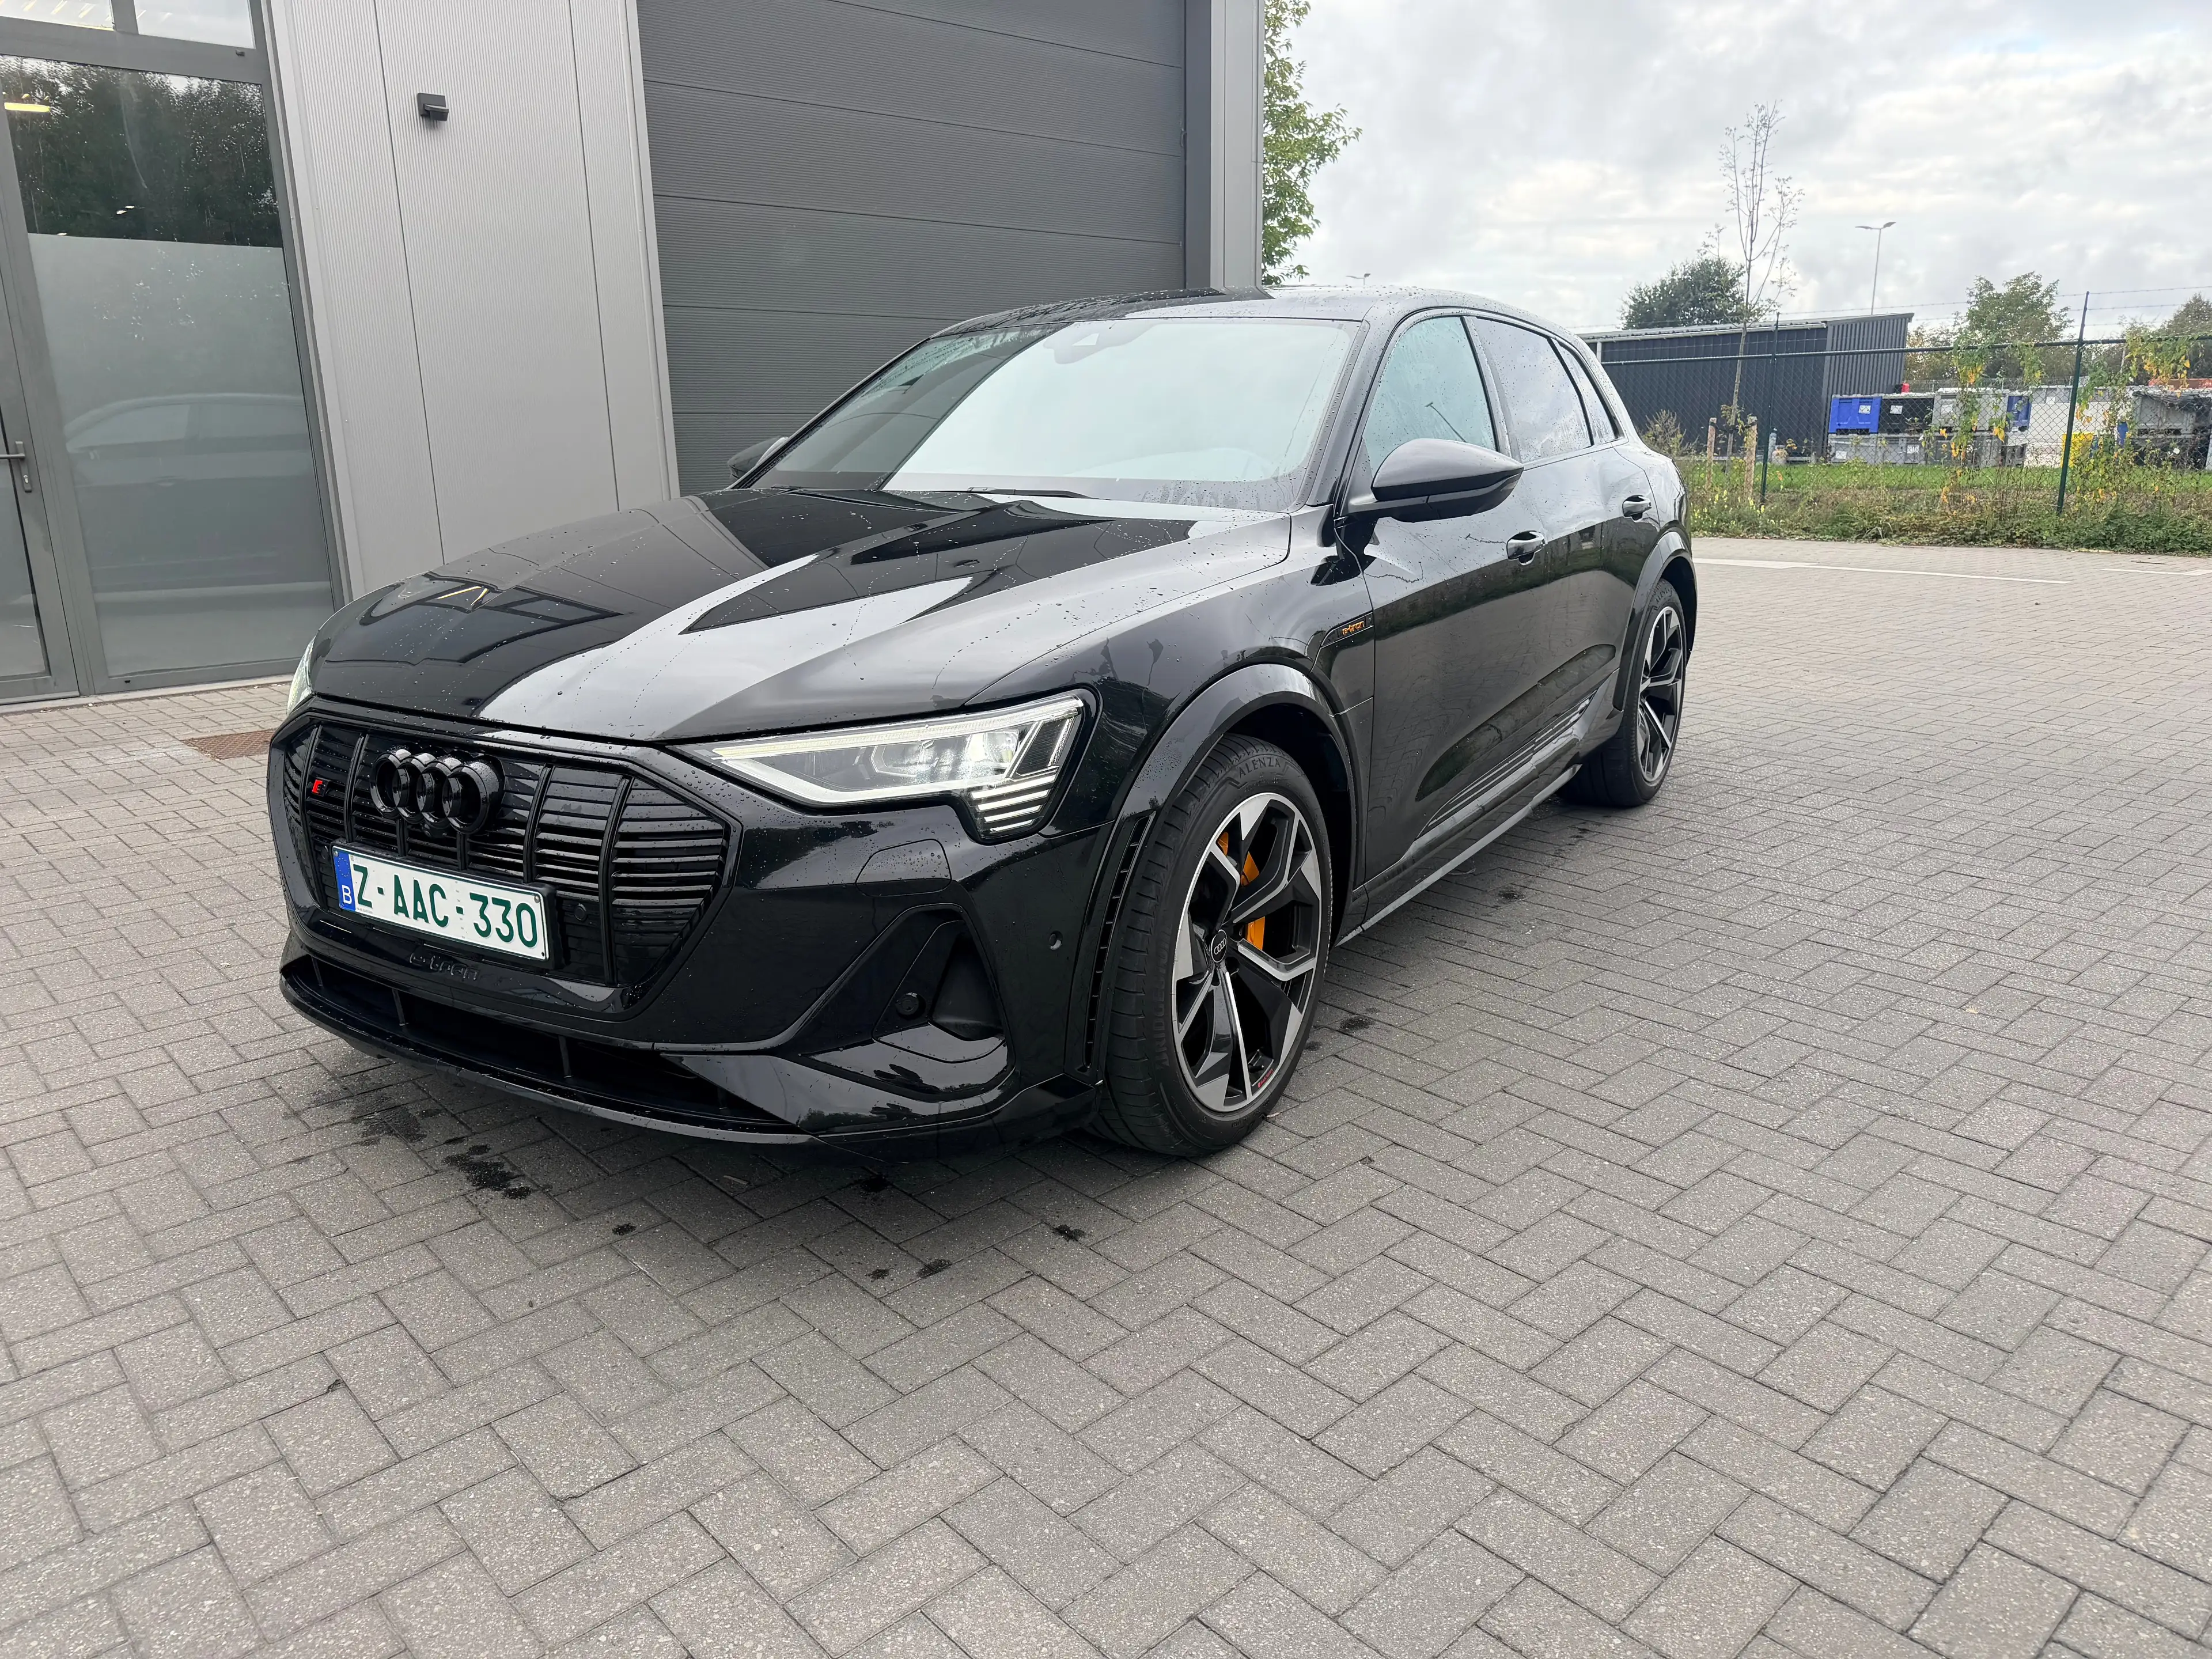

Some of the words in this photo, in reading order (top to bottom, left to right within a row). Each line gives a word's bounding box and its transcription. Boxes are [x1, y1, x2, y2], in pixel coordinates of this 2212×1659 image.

[1342, 621, 1365, 635] e-tron
[1238, 756, 1281, 778] ALENZA
[341, 884, 353, 904] B
[353, 863, 538, 948] Z-AAC-330
